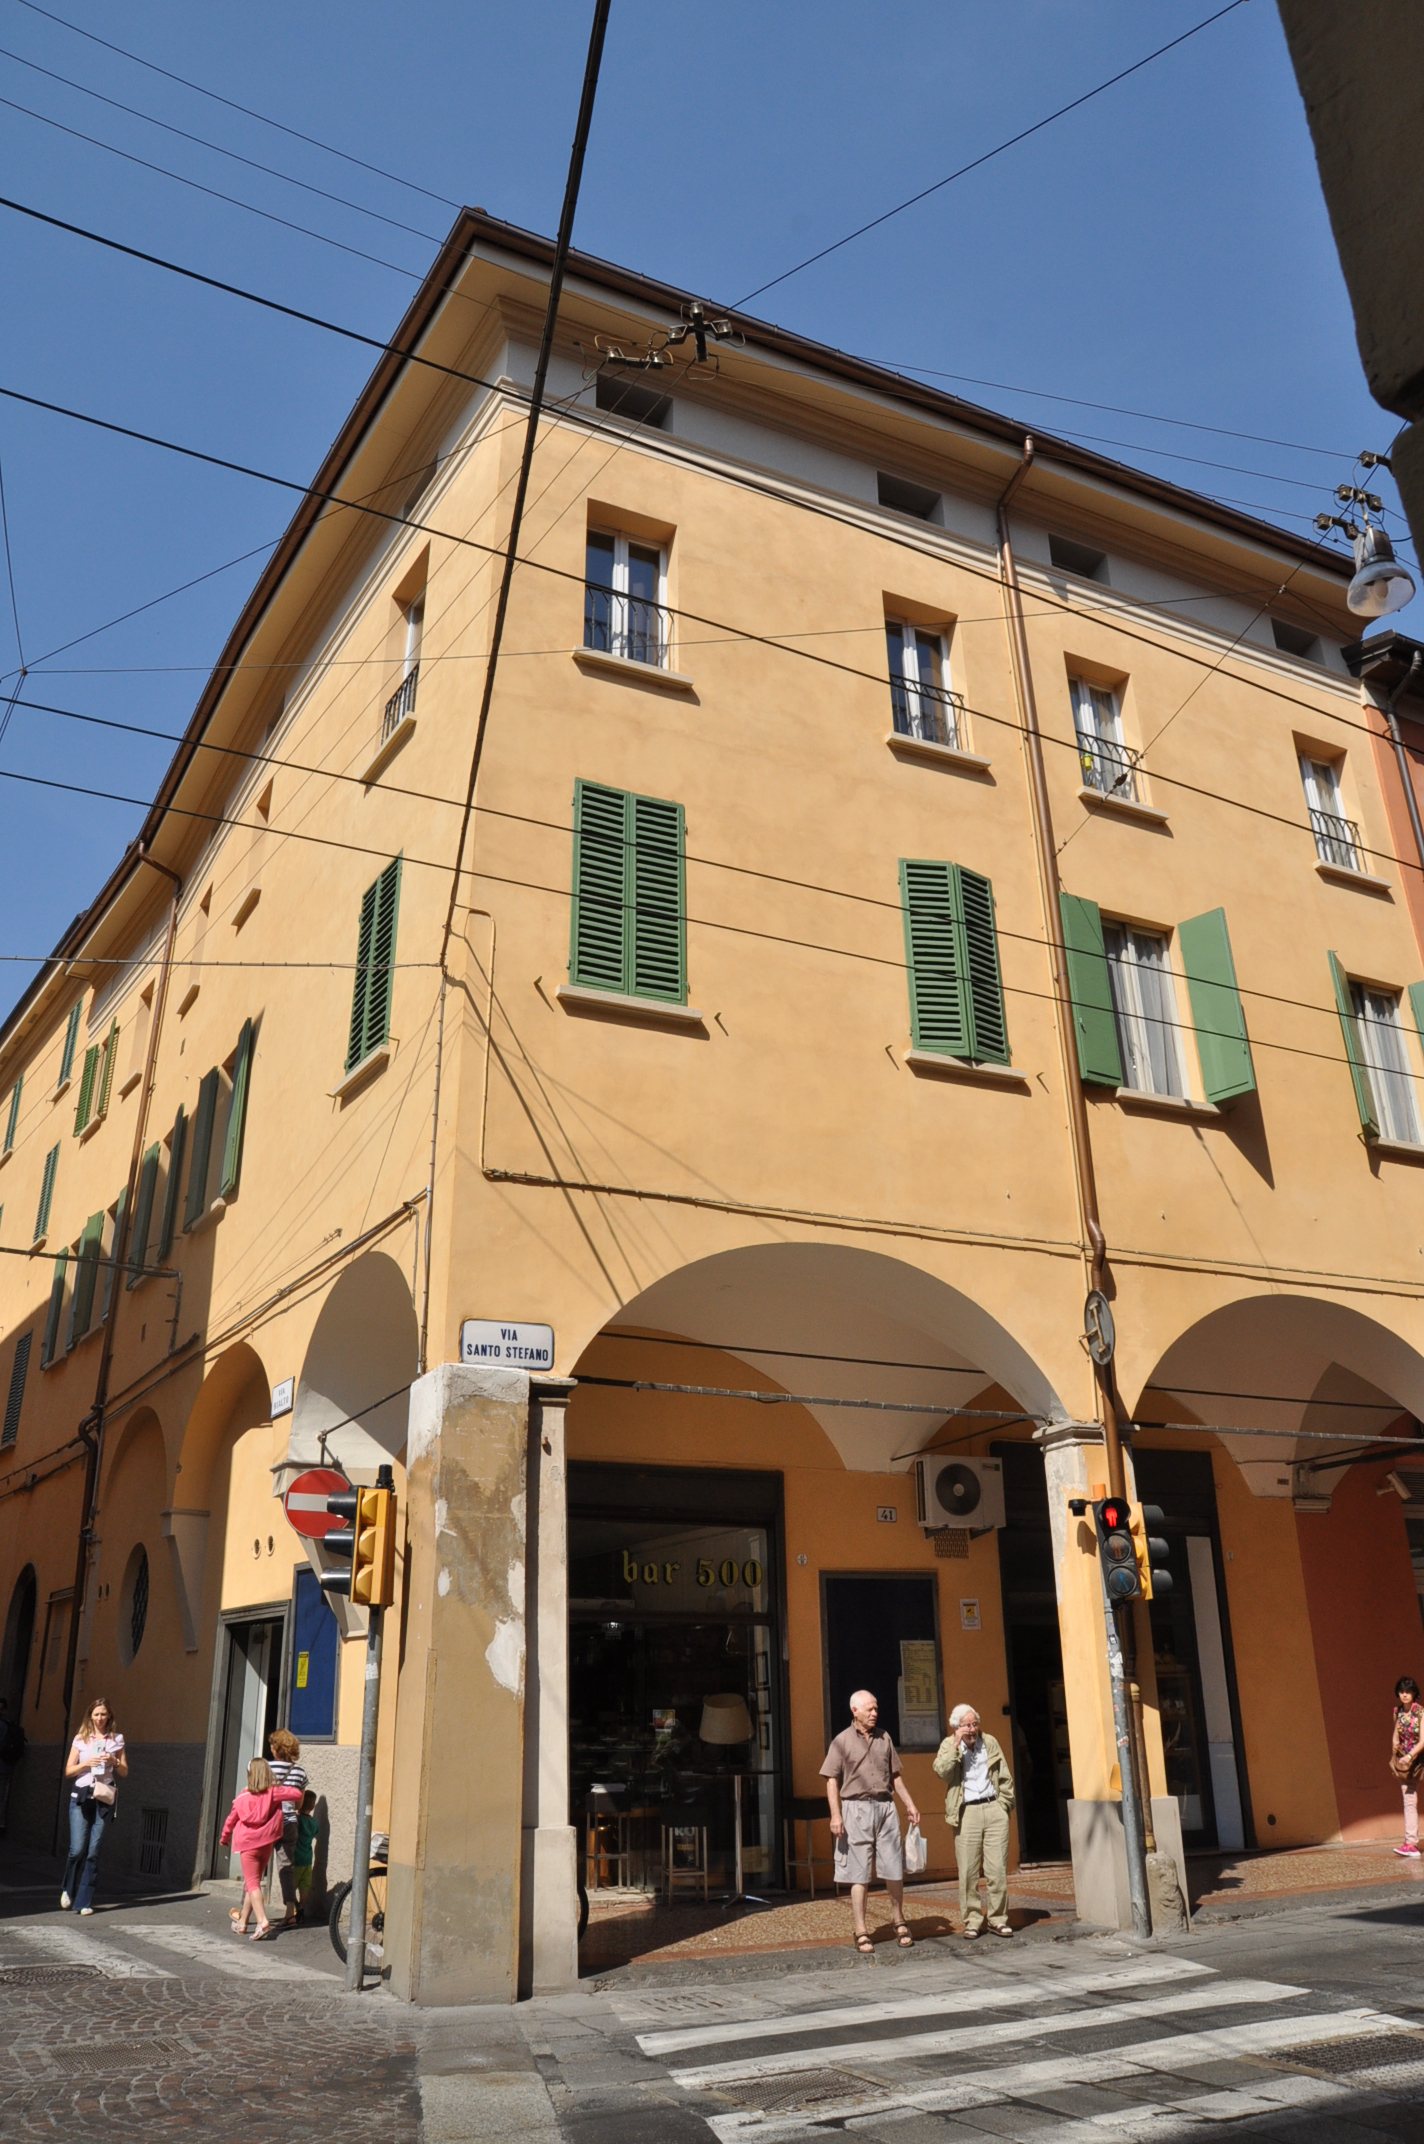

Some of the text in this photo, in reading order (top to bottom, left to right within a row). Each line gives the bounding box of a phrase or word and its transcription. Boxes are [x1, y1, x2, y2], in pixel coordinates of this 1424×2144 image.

[500, 1328, 518, 1342] VIA
[466, 1343, 549, 1362] SANTO STEFANO
[880, 1509, 893, 1521] 41
[622, 1549, 764, 1588] bar 500
